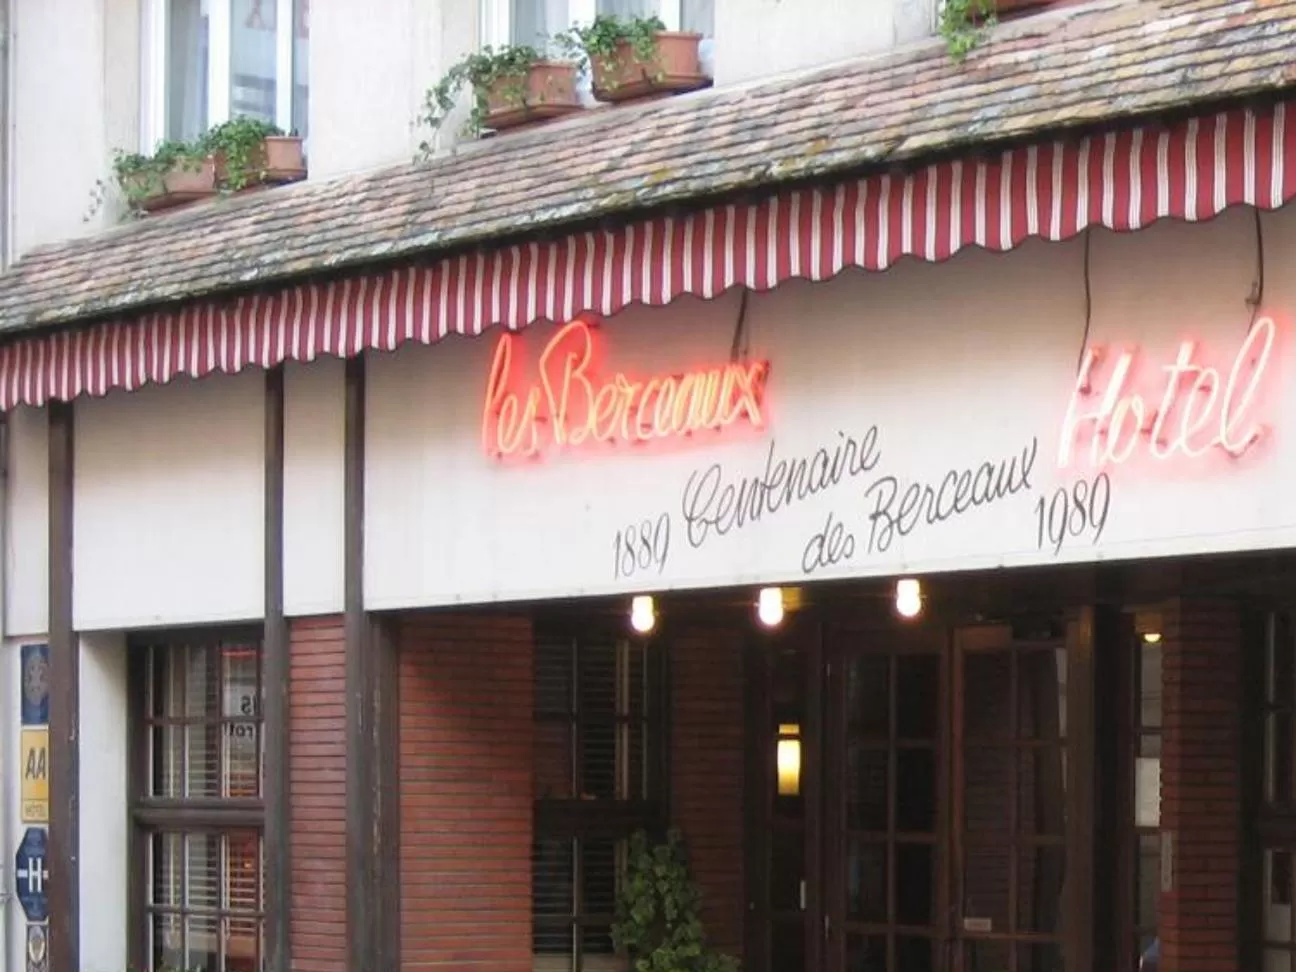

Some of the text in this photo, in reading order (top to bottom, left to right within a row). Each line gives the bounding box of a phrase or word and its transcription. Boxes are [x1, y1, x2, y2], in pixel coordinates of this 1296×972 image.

[539, 320, 769, 447] Berceaux
[1057, 316, 1275, 469] Hotel
[614, 425, 881, 579] 1889 Centenaire
[802, 436, 1110, 573] des Berceaux 1989
[25, 747, 46, 780] AA
[28, 857, 42, 893] H
